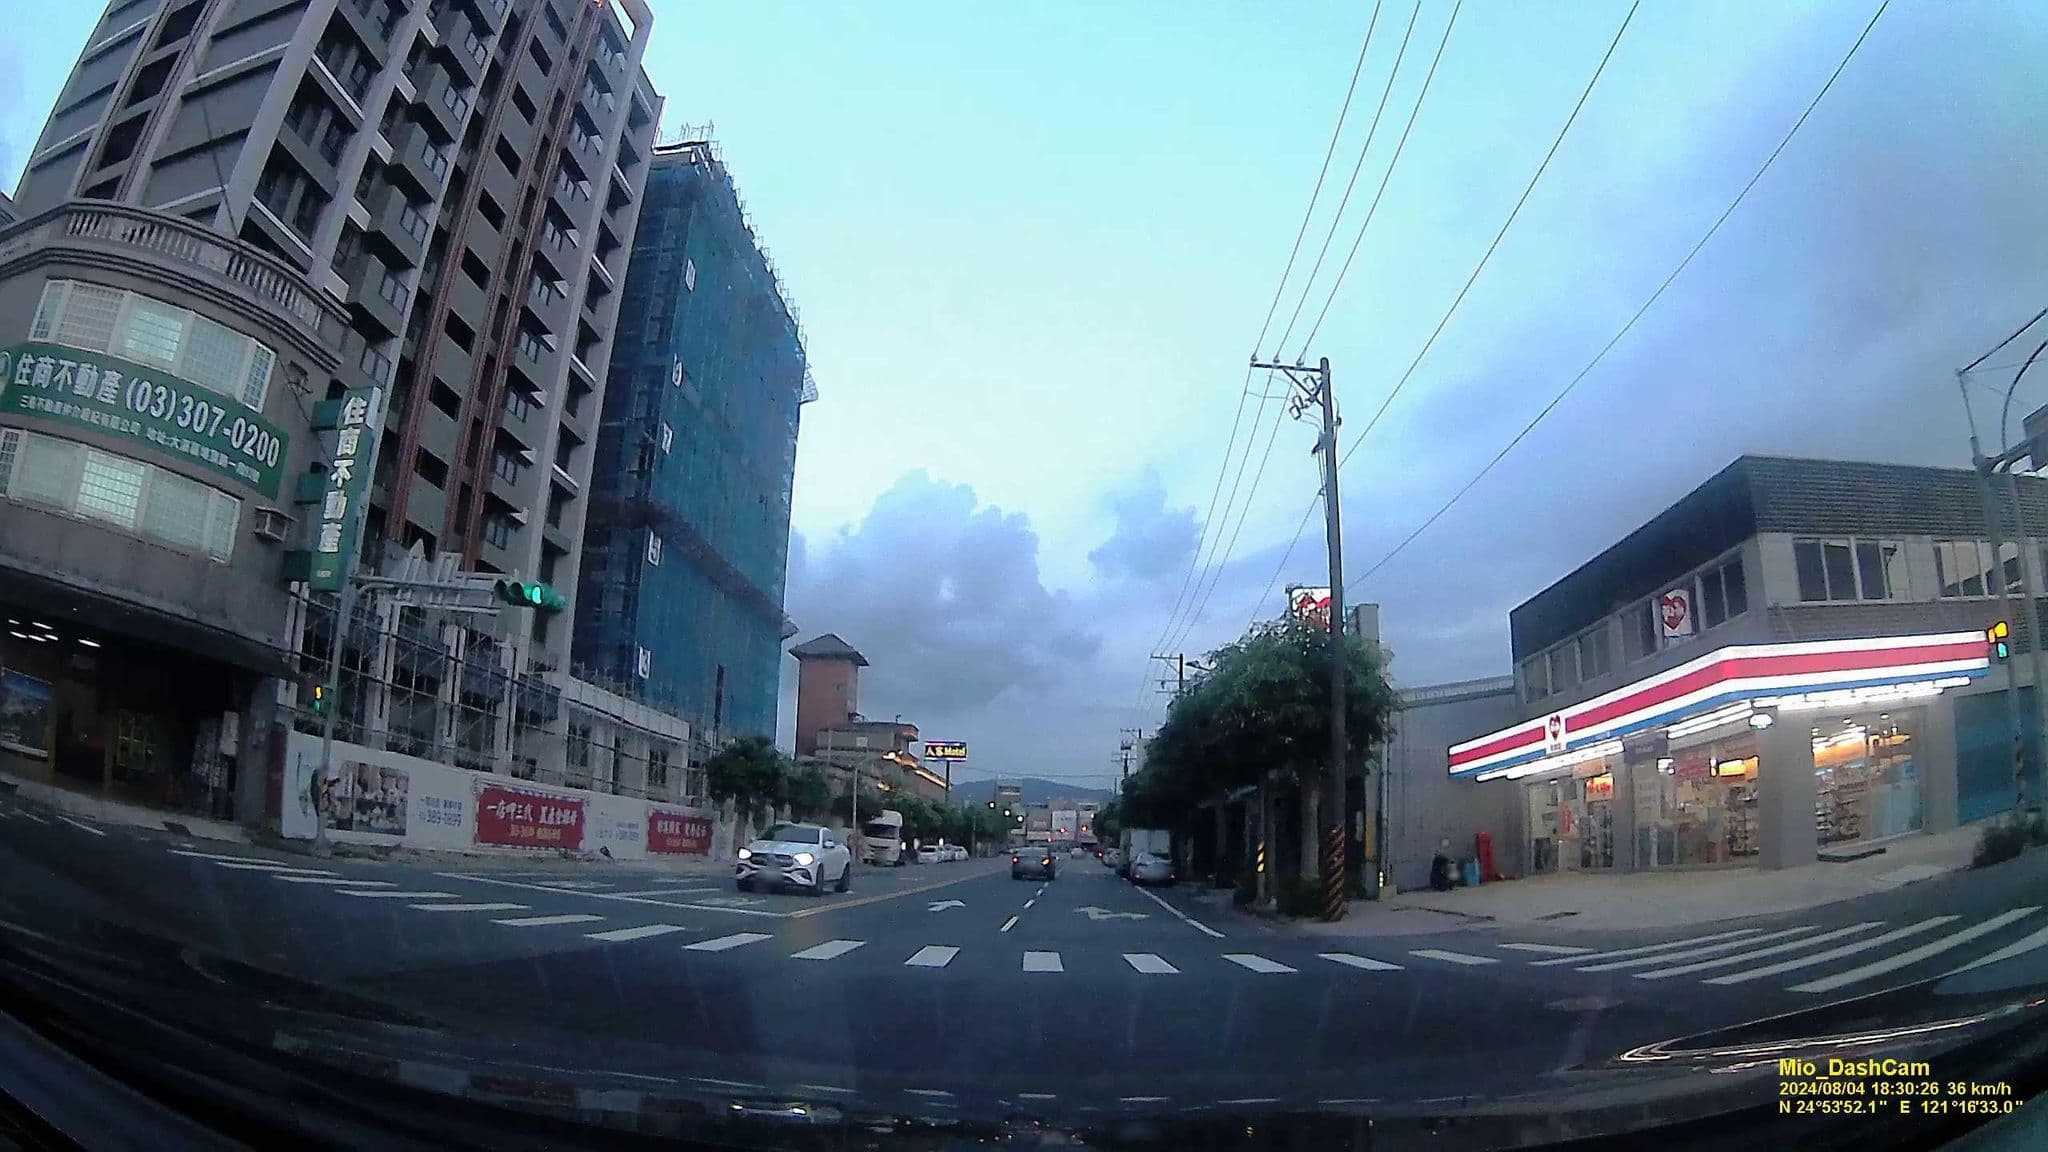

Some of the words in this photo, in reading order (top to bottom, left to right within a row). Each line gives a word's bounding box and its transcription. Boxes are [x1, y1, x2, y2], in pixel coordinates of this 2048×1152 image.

[14, 352, 124, 405] 住商不動產
[125, 377, 280, 468] (03)307-0200
